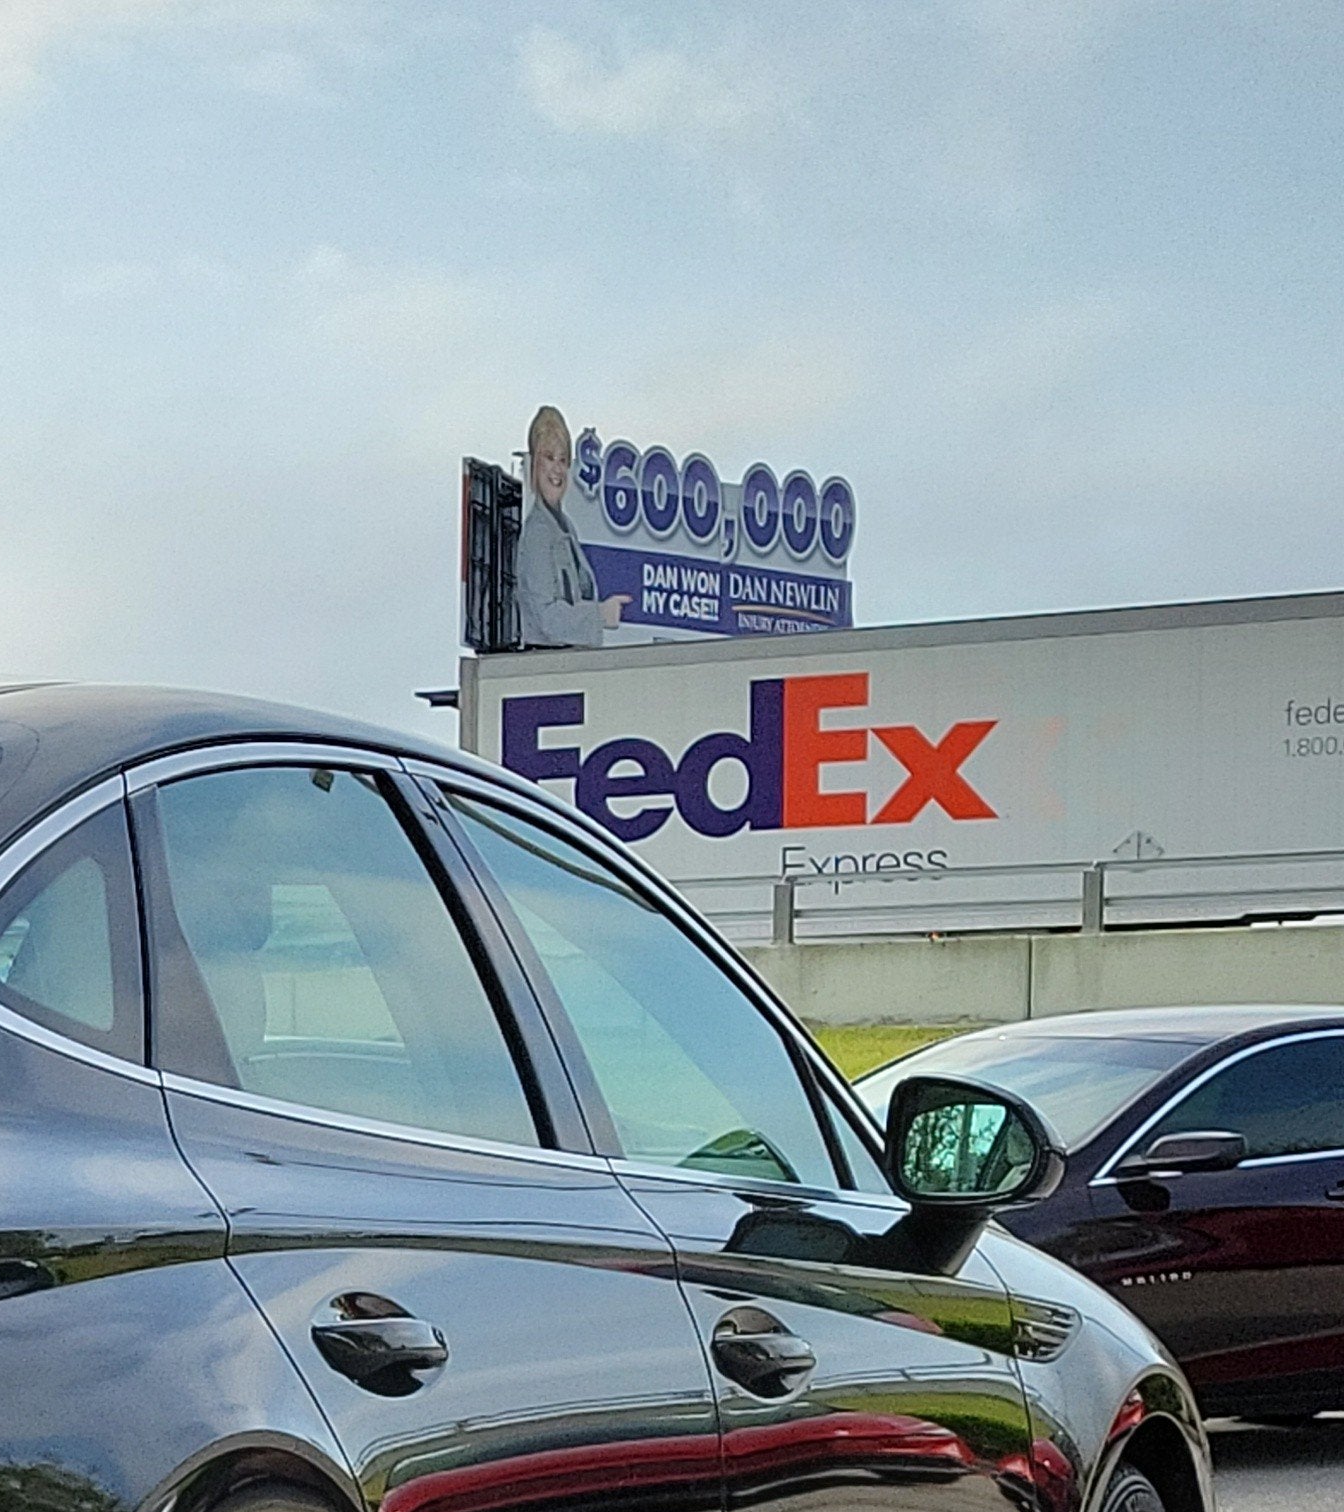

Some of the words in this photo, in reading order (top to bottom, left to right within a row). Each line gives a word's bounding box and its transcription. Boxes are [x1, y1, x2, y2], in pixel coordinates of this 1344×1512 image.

[576, 428, 855, 559] $600,000
[643, 563, 678, 589] DAN
[681, 568, 720, 597] WON
[729, 573, 770, 603] DAN
[771, 581, 840, 612] NEWLIN
[642, 590, 668, 615] MY
[501, 671, 999, 843] FedEx
